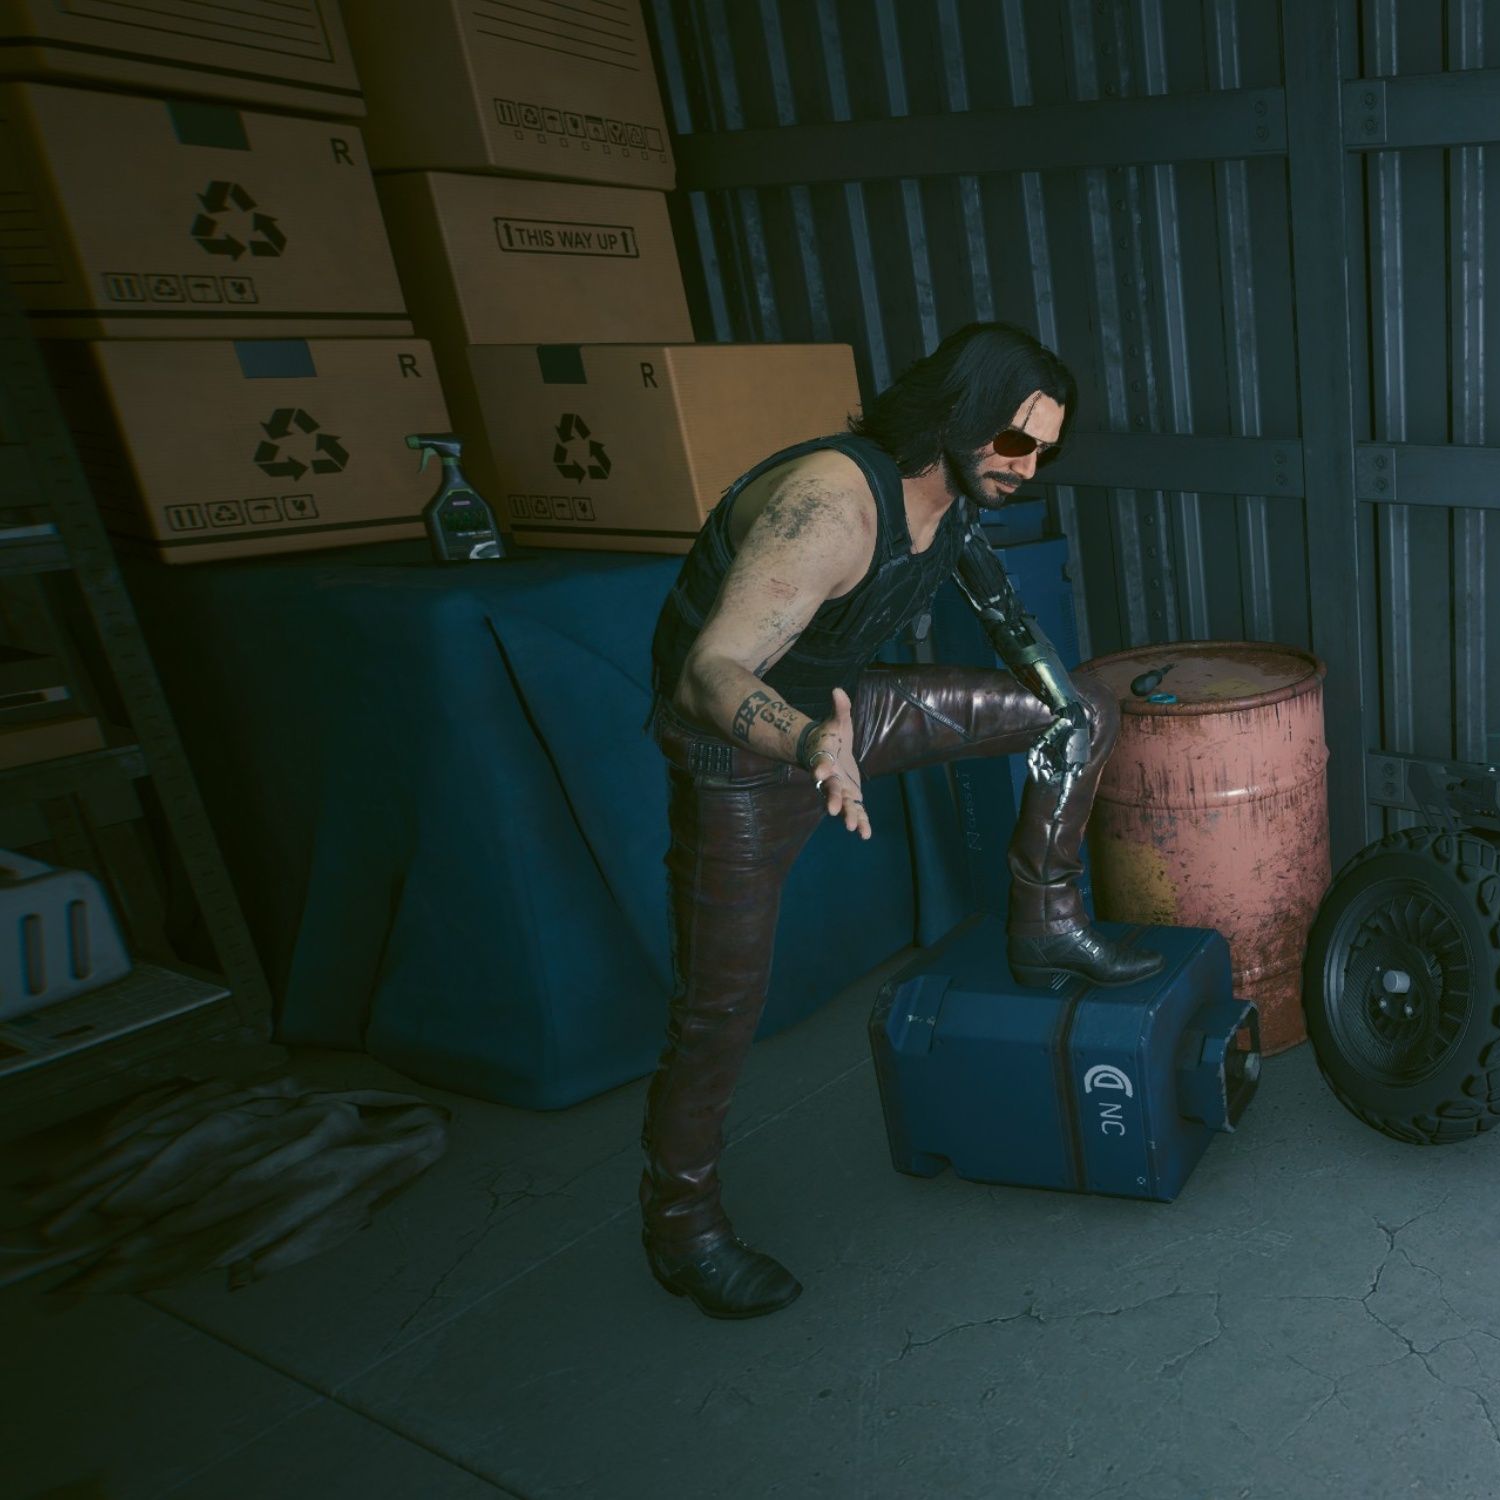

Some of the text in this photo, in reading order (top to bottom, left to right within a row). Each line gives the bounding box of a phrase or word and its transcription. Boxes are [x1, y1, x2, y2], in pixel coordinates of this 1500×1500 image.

[330, 138, 355, 167] R
[515, 227, 617, 250] THIS WAY UP
[397, 353, 422, 378] R
[640, 362, 659, 389] R
[1098, 1102, 1126, 1137] NC
